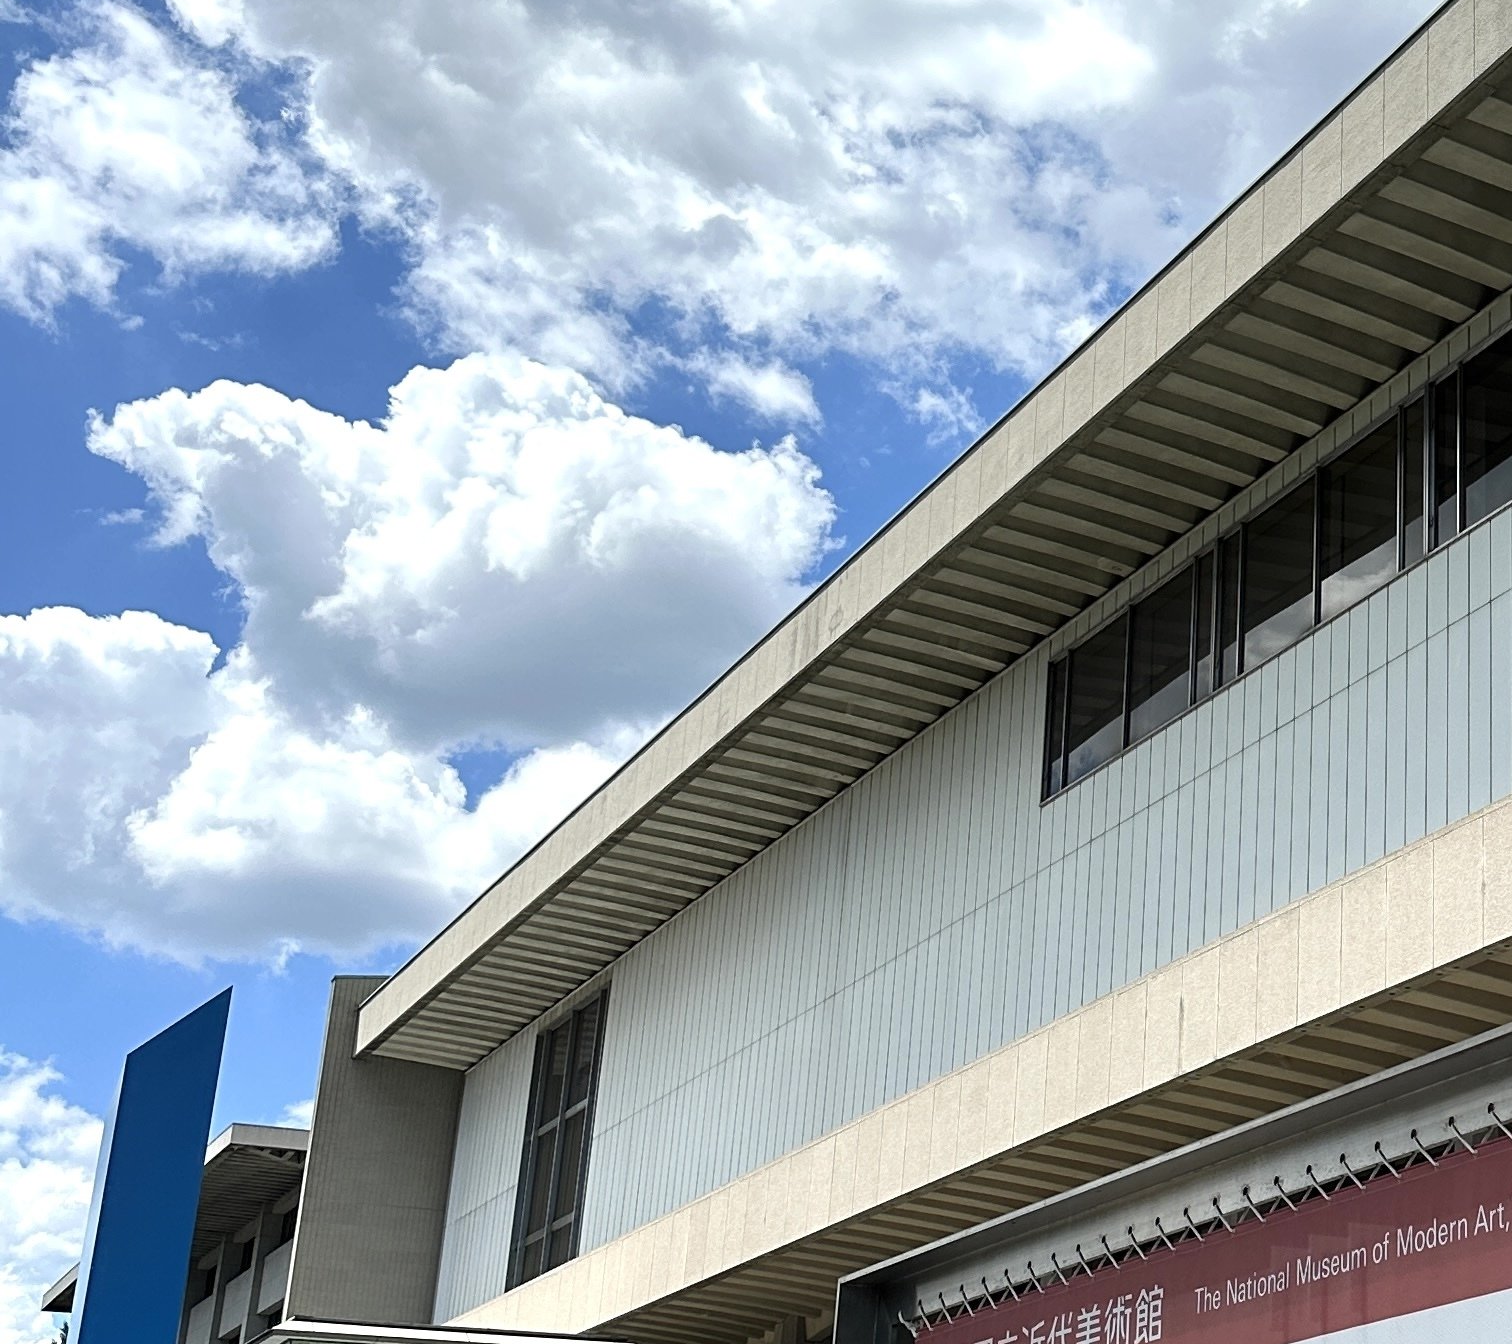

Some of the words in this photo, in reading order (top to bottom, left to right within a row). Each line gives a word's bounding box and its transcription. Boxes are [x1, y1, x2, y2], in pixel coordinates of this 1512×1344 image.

[1195, 1286, 1221, 1314] The
[1225, 1266, 1289, 1306] National
[1296, 1244, 1367, 1286] Museum
[1371, 1235, 1389, 1266] of
[1396, 1217, 1468, 1256] Modern
[1474, 1202, 1510, 1239] Art,
